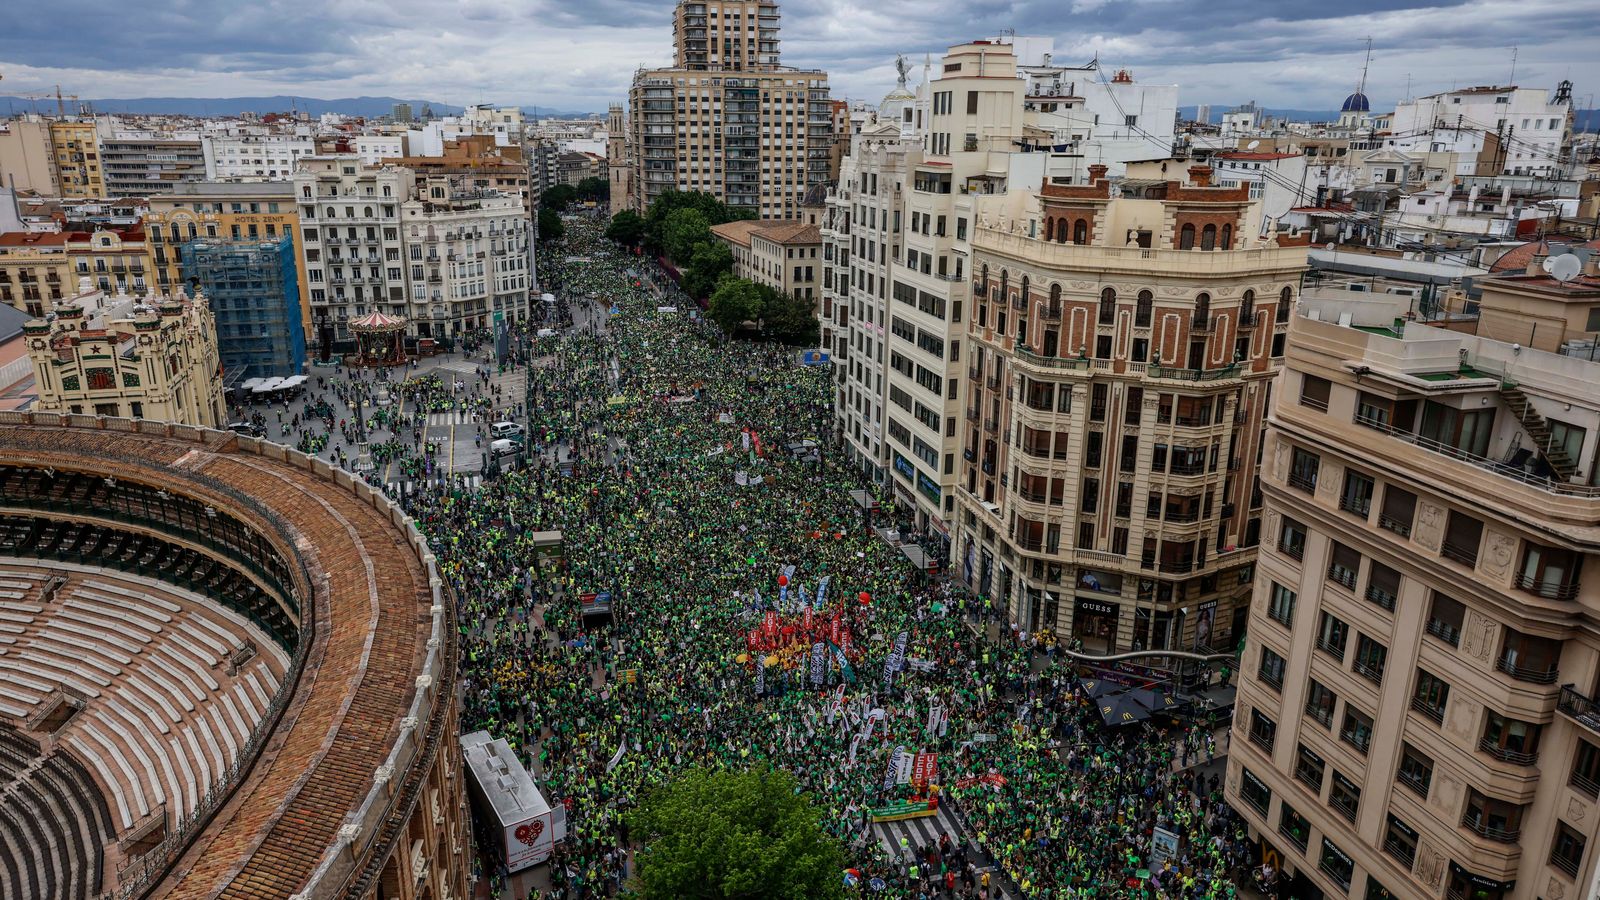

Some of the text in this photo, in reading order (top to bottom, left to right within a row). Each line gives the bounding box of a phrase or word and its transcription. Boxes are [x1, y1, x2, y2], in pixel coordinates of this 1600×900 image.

[1082, 602, 1111, 613] GUESS
[1200, 601, 1217, 610] GUESS
[887, 759, 900, 780] CSIF
[916, 756, 925, 779] CCOO
[926, 755, 935, 776] UGT
